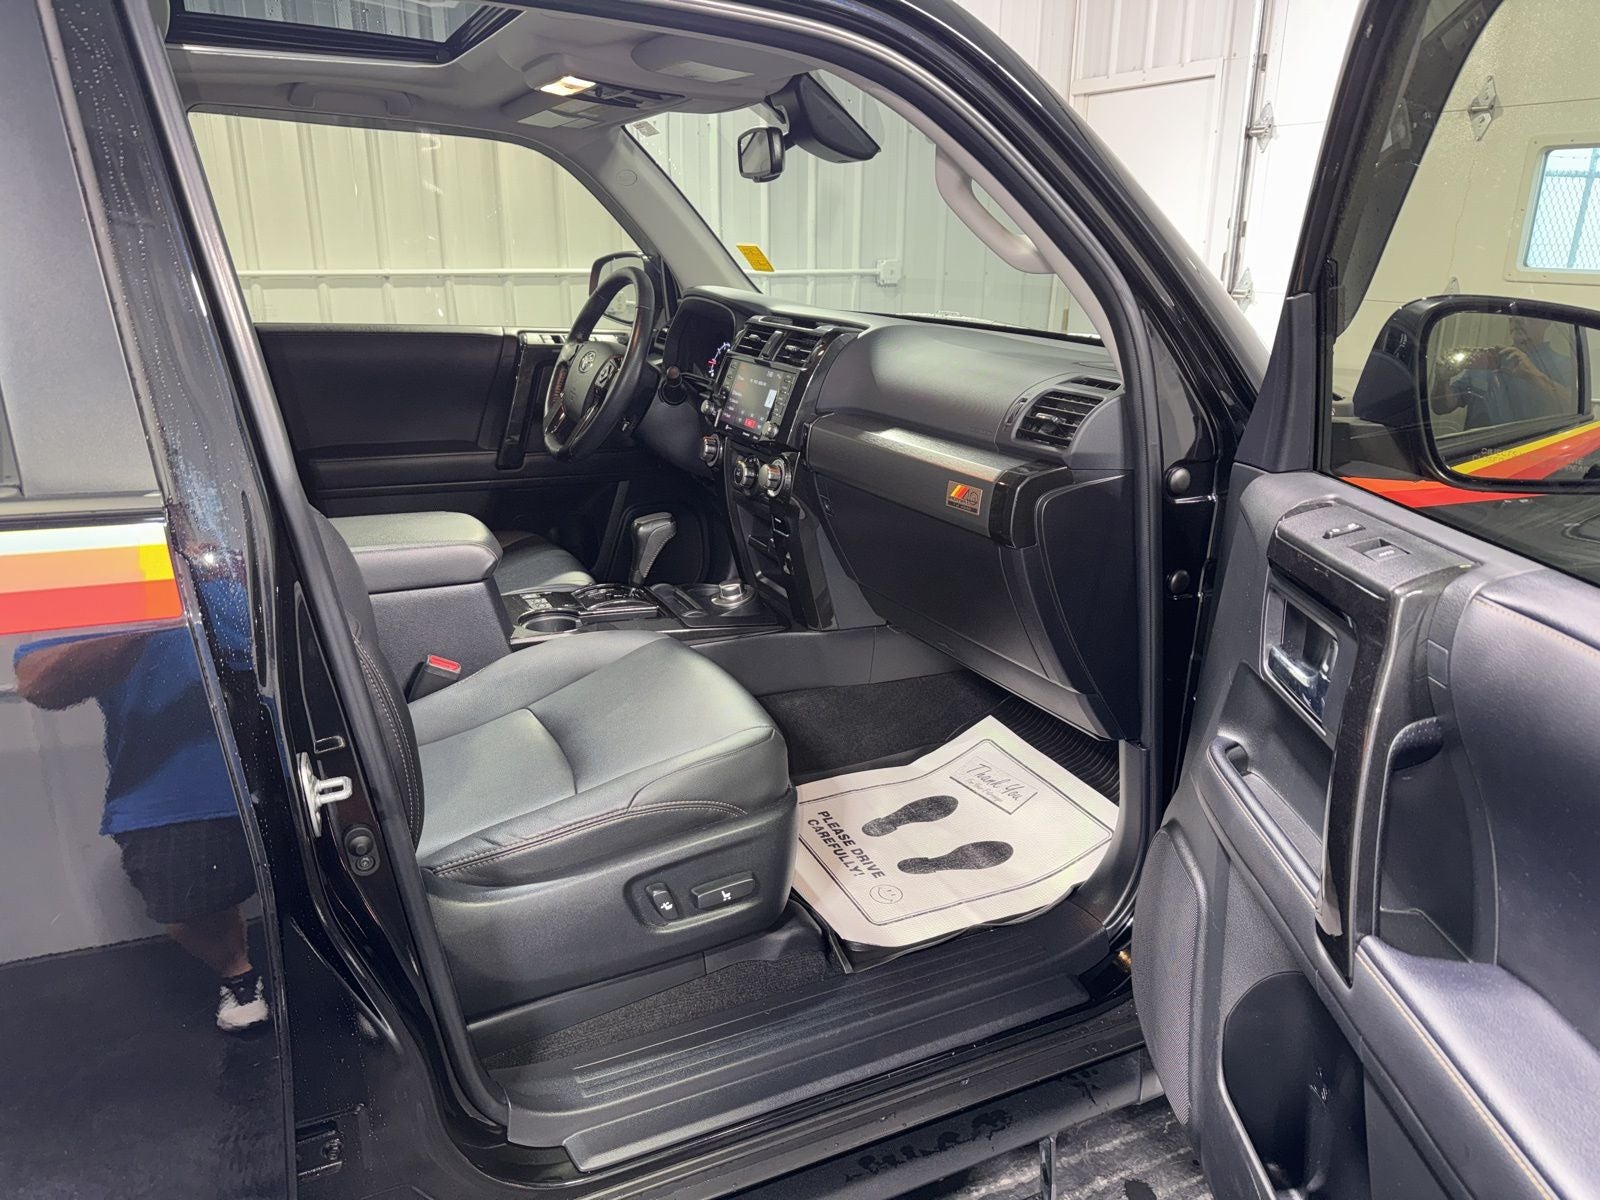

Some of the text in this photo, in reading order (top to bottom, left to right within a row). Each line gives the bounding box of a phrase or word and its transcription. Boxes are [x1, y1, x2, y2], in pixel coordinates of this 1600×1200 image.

[966, 763, 1011, 788] Thank
[1001, 783, 1025, 801] You
[807, 819, 865, 877] CAREFULLY!
[818, 811, 886, 879] PLEASE DRIVE
